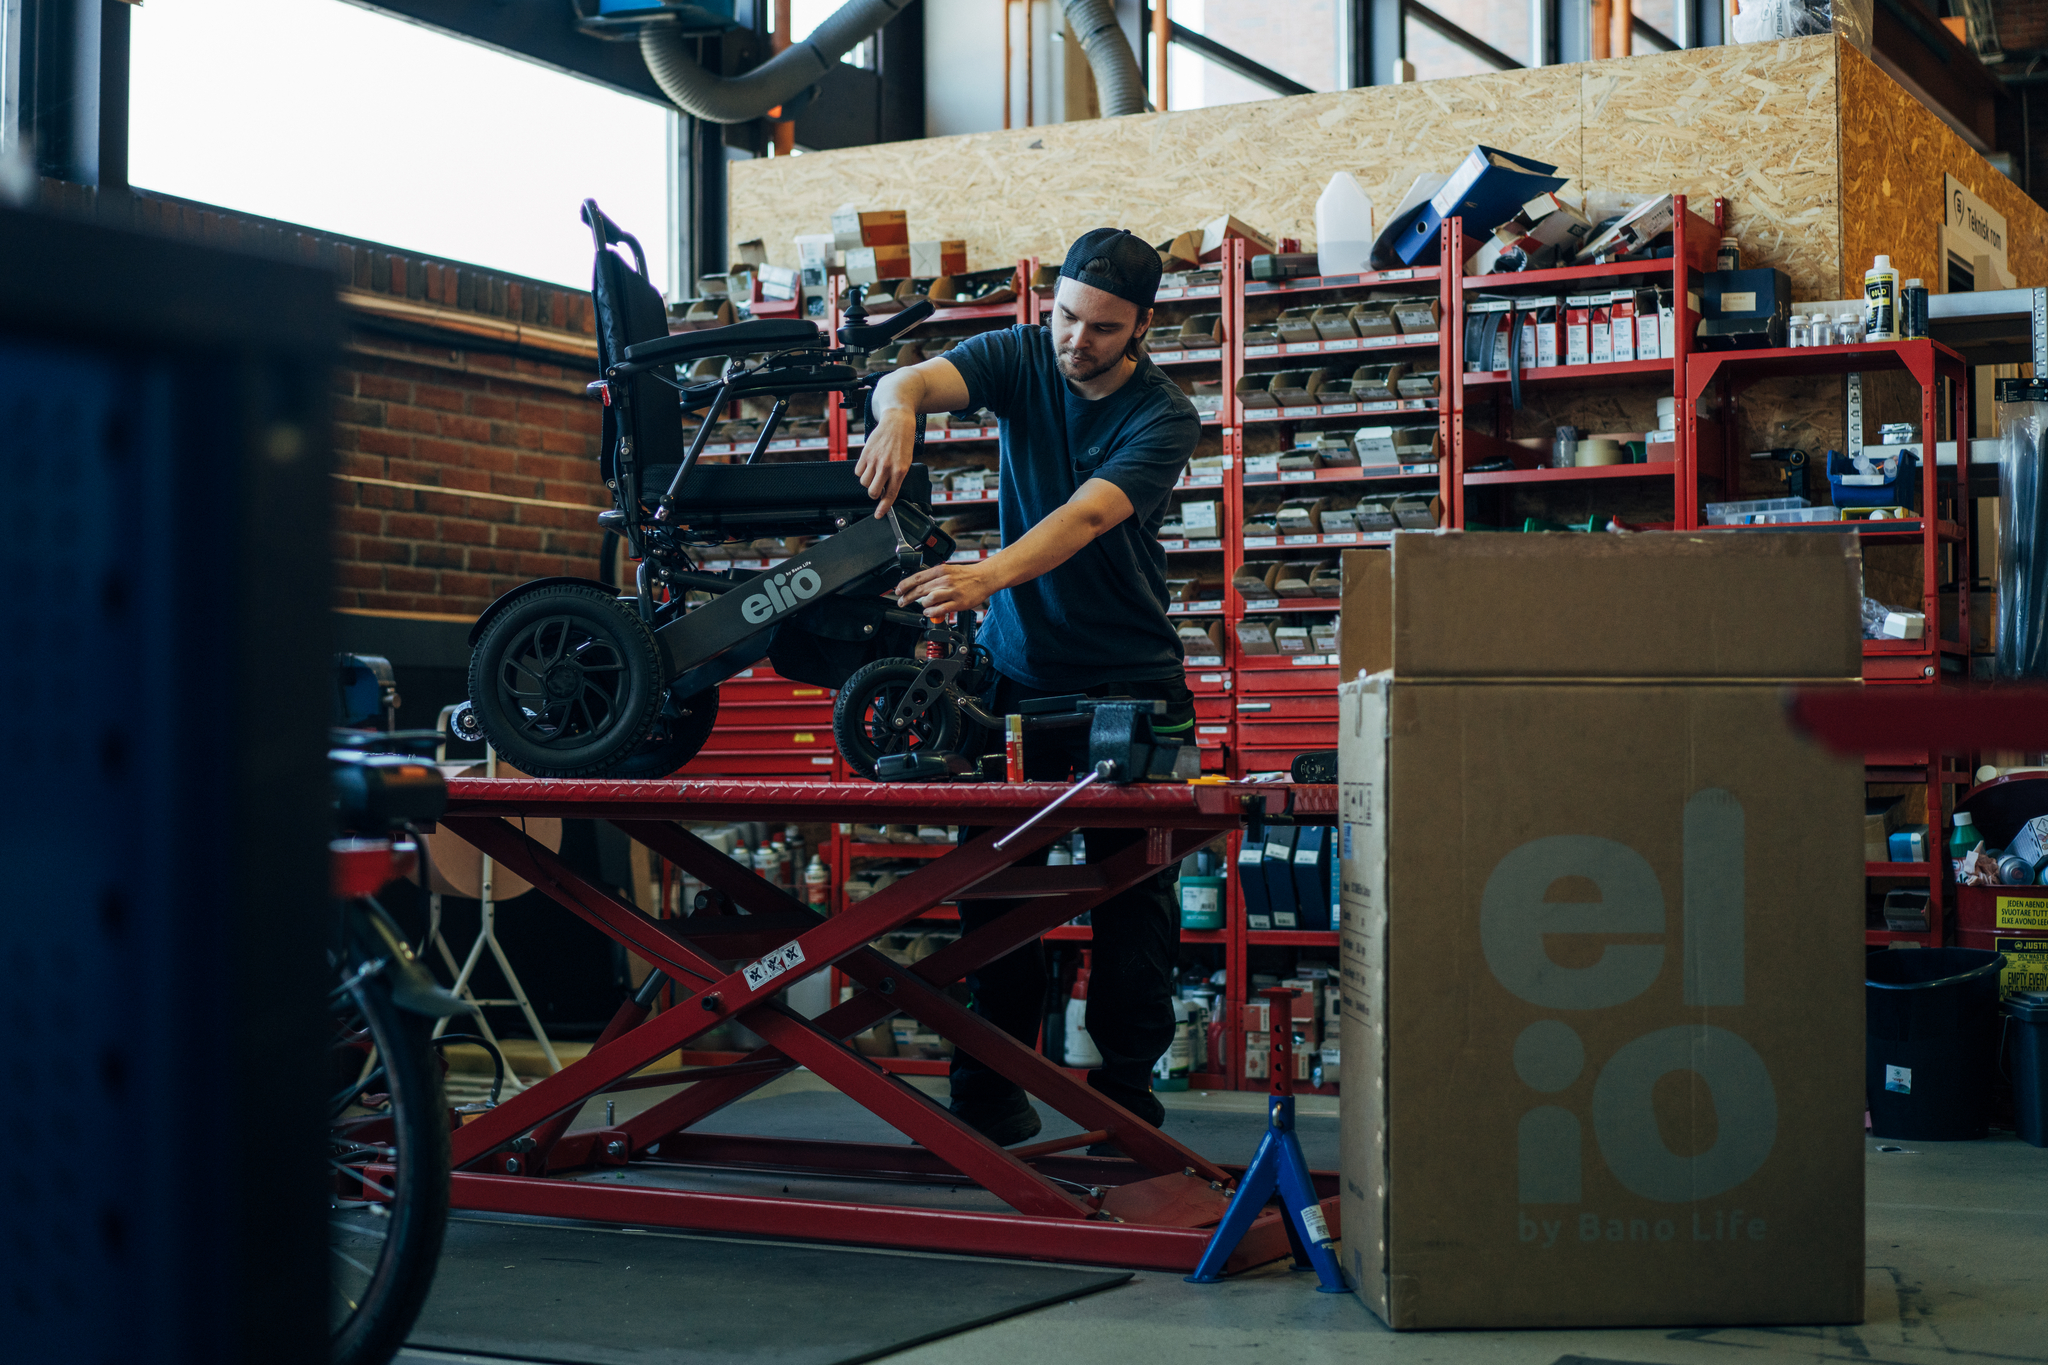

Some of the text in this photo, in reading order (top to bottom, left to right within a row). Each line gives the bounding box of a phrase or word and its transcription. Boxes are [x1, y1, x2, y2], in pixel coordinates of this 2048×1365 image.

[1967, 206, 2002, 251] Teknisk rom
[741, 568, 822, 625] elio
[2007, 900, 2024, 908] JEDEN
[2025, 900, 2045, 908] ABEND
[2001, 908, 2031, 917] SVUOTARE
[2015, 917, 2037, 925] AVOND
[2037, 918, 2048, 926] LEE
[2008, 971, 2048, 986] EMPTY EVERY
[1518, 1209, 1767, 1248] by Bano Life
